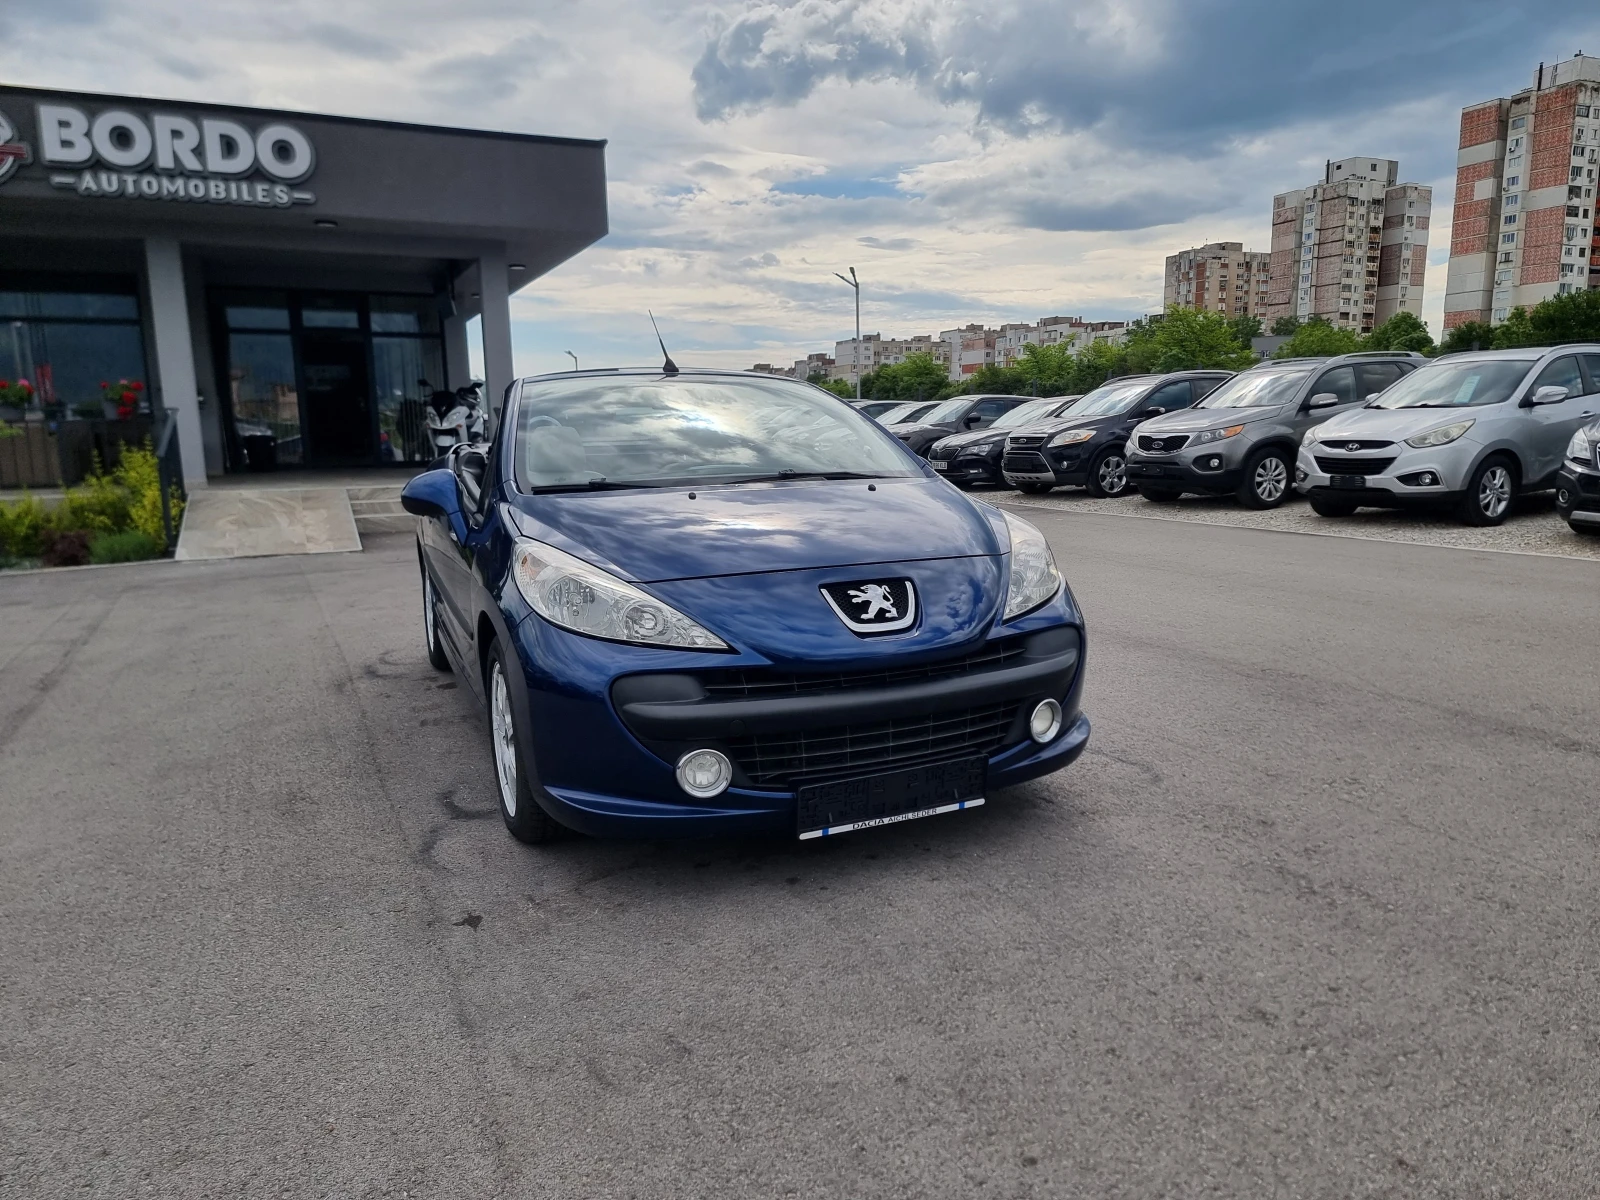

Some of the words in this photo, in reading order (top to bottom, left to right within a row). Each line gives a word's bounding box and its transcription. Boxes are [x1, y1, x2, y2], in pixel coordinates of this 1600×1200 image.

[39, 104, 311, 179] BORDO
[80, 173, 289, 204] AUTOMOBILES
[852, 818, 885, 830] DACIA
